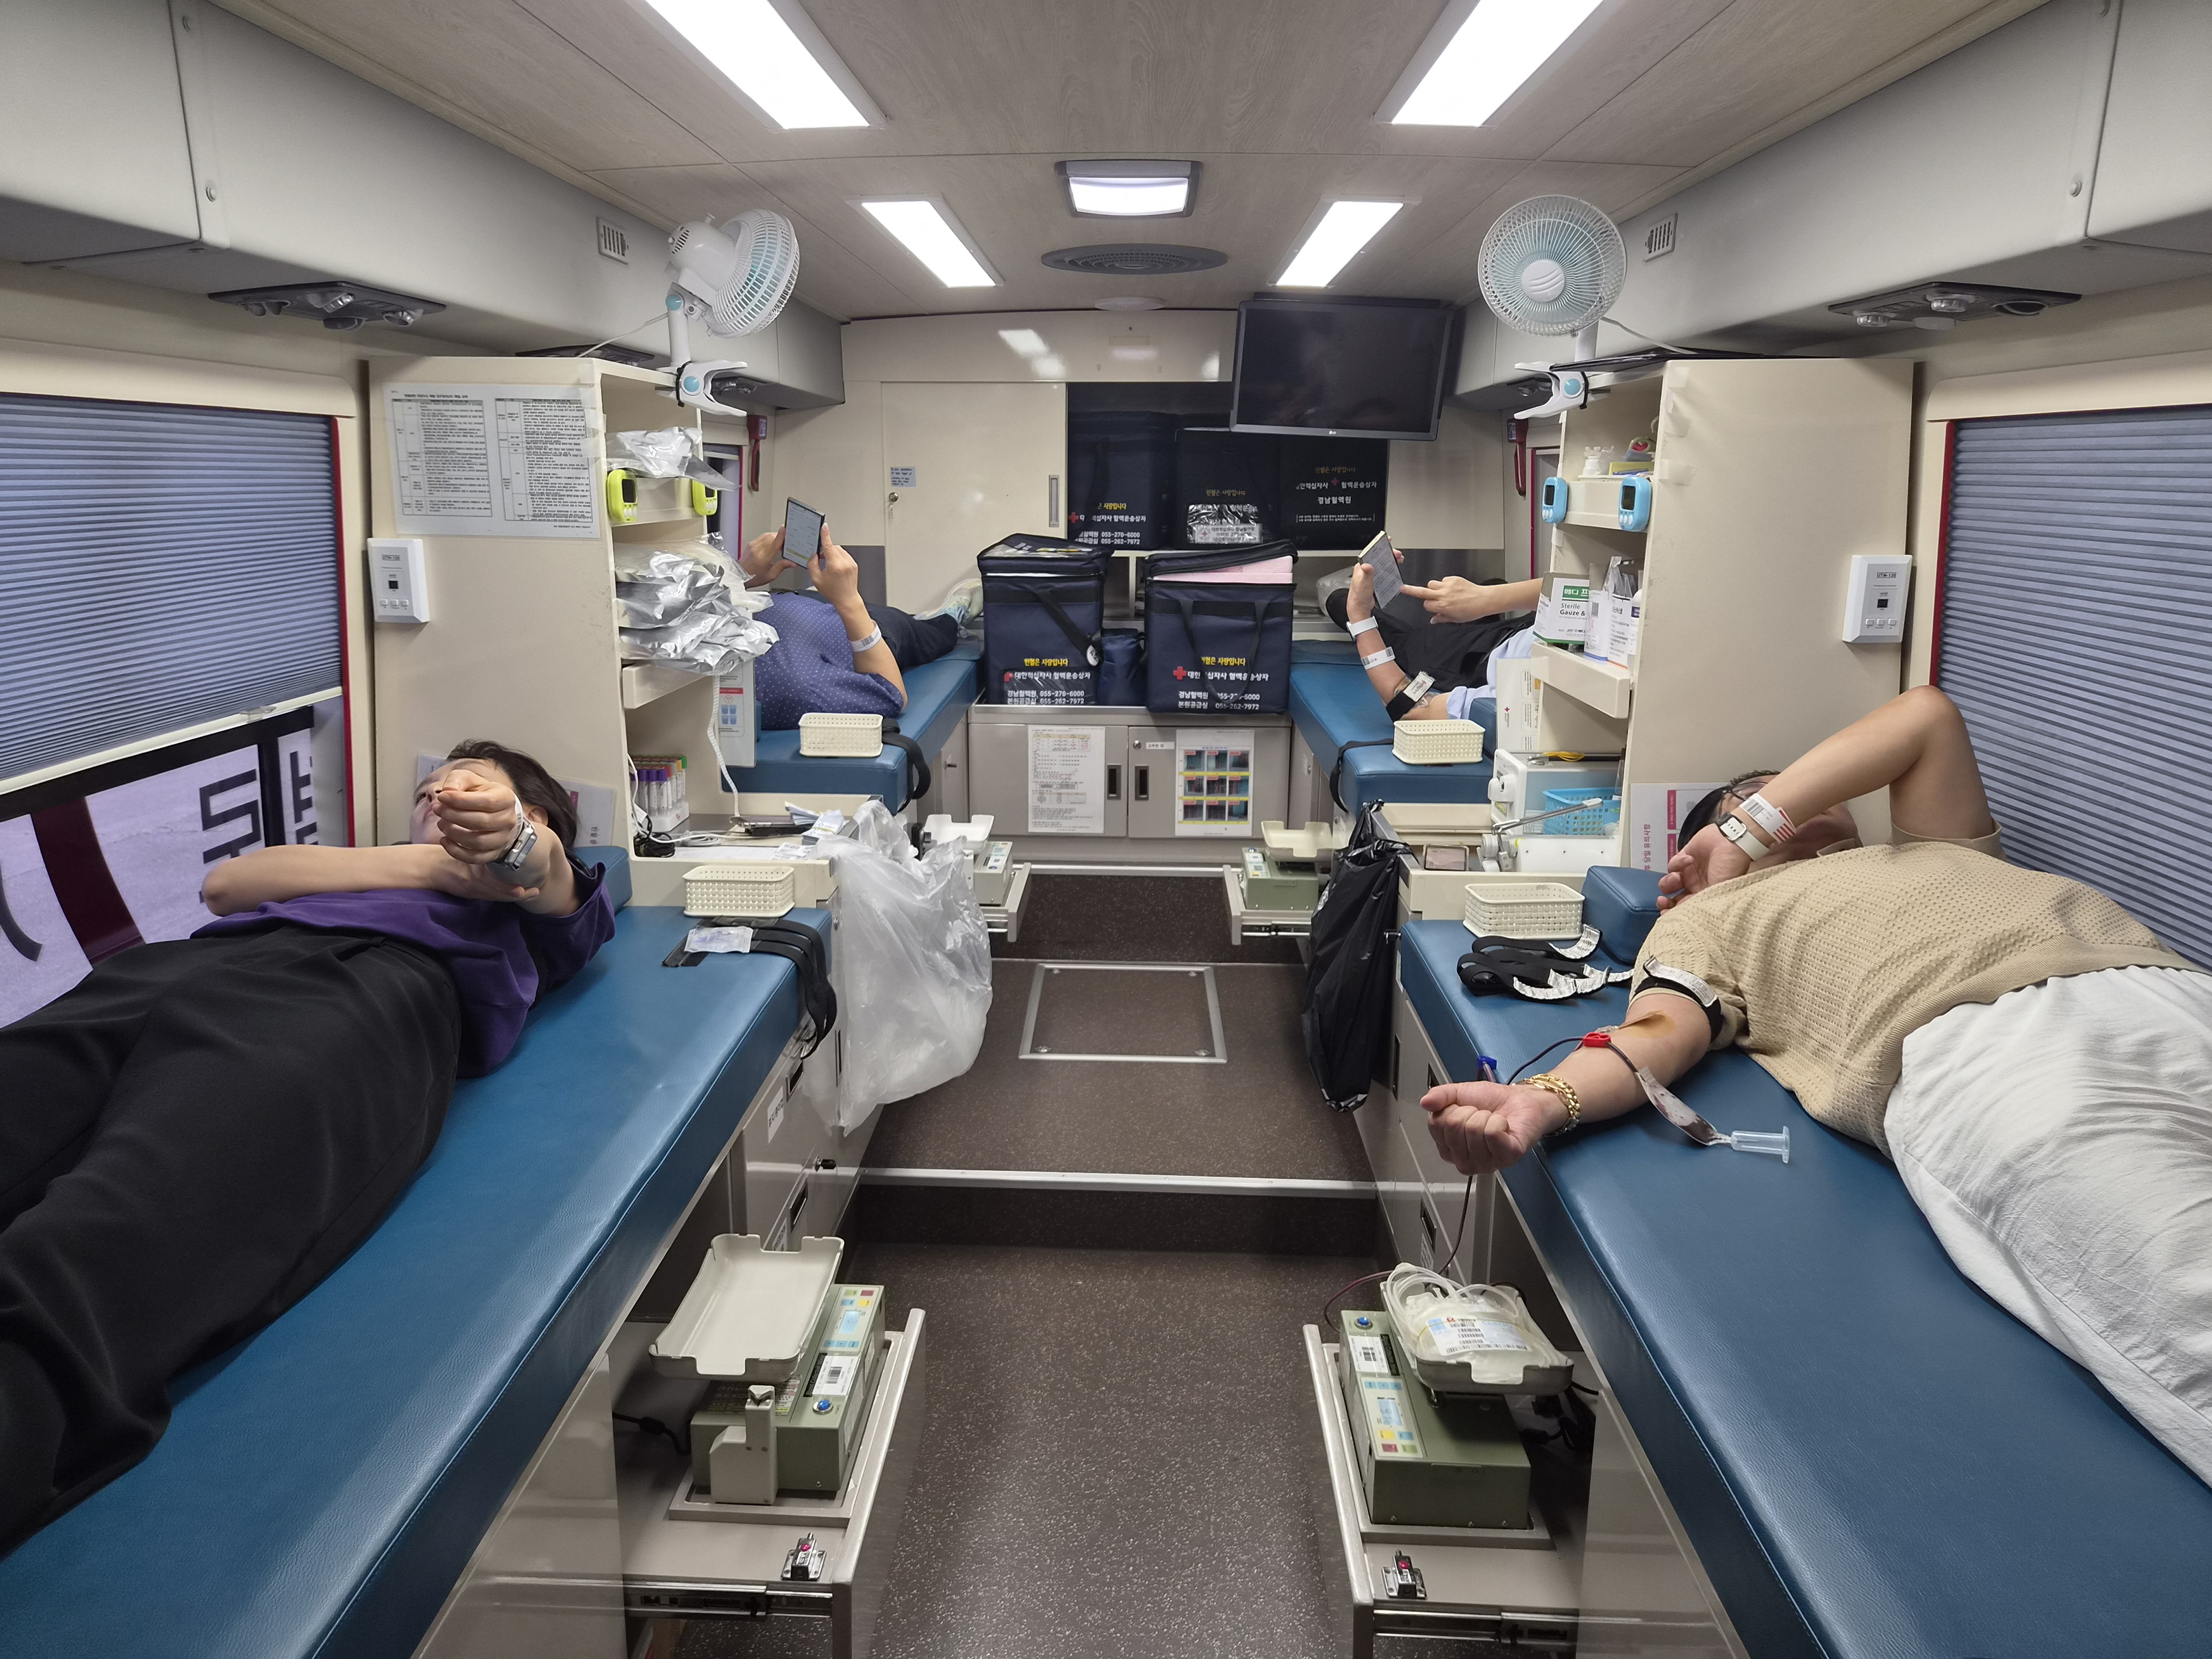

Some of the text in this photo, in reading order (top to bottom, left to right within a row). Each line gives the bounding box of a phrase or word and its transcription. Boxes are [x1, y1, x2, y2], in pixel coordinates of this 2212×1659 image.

[1318, 496, 1352, 504] 경남혈액원
[1024, 658, 1068, 666] 헌혈은 사랑입니다
[1217, 658, 1246, 666] 사랑입니다
[1187, 671, 1228, 680] 대한십자사
[1178, 691, 1208, 700] 경남혈액원
[1643, 823, 1651, 849] 유의사항
[1643, 851, 1651, 863] 당일
